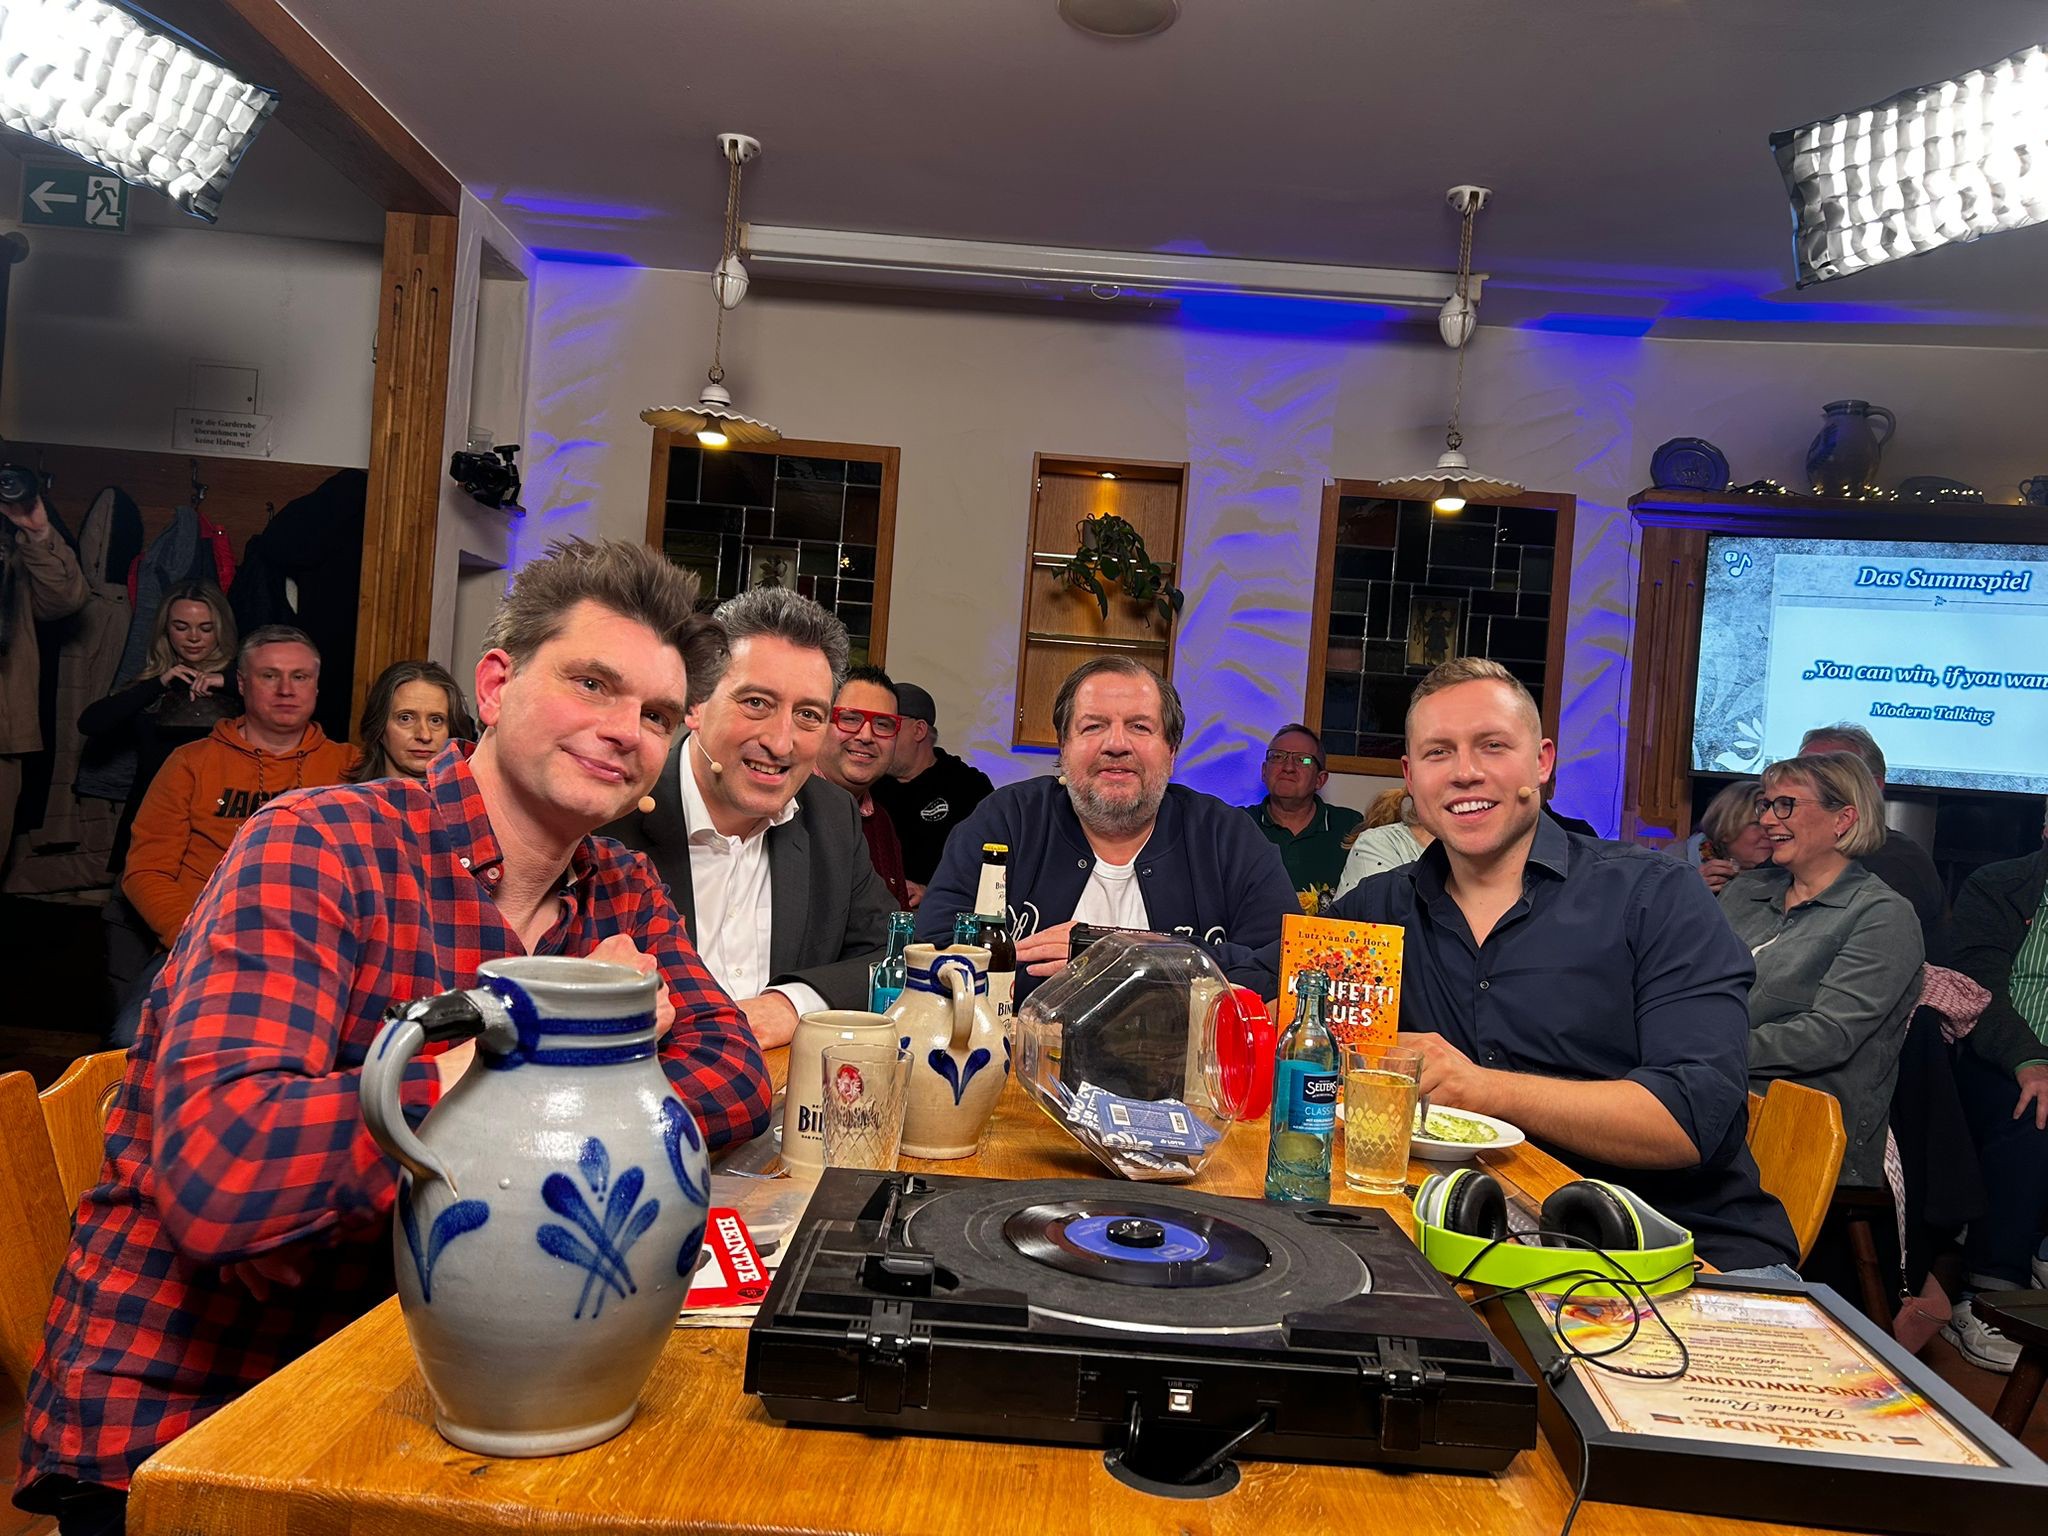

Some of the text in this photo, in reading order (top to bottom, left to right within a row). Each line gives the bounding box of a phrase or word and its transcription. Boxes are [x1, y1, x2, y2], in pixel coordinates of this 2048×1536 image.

[218, 419, 256, 430] Garderobe
[215, 438, 246, 449] Haftung
[1857, 567, 2031, 594] Das Summspiel
[1856, 666, 1891, 681] can
[1896, 665, 1939, 686] win,
[1944, 667, 1965, 690] if
[1962, 671, 2000, 690] you
[1871, 703, 1995, 725] Modern Talking
[213, 788, 289, 818] JAC
[1298, 930, 1391, 948] Lutz van der Horst
[1288, 975, 1395, 1005] KNFETTI
[1325, 1004, 1374, 1027] UES
[1305, 1081, 1337, 1095] SELTERS
[715, 1215, 762, 1284] HEINTJE
[1766, 1400, 1846, 1420] Patrick
